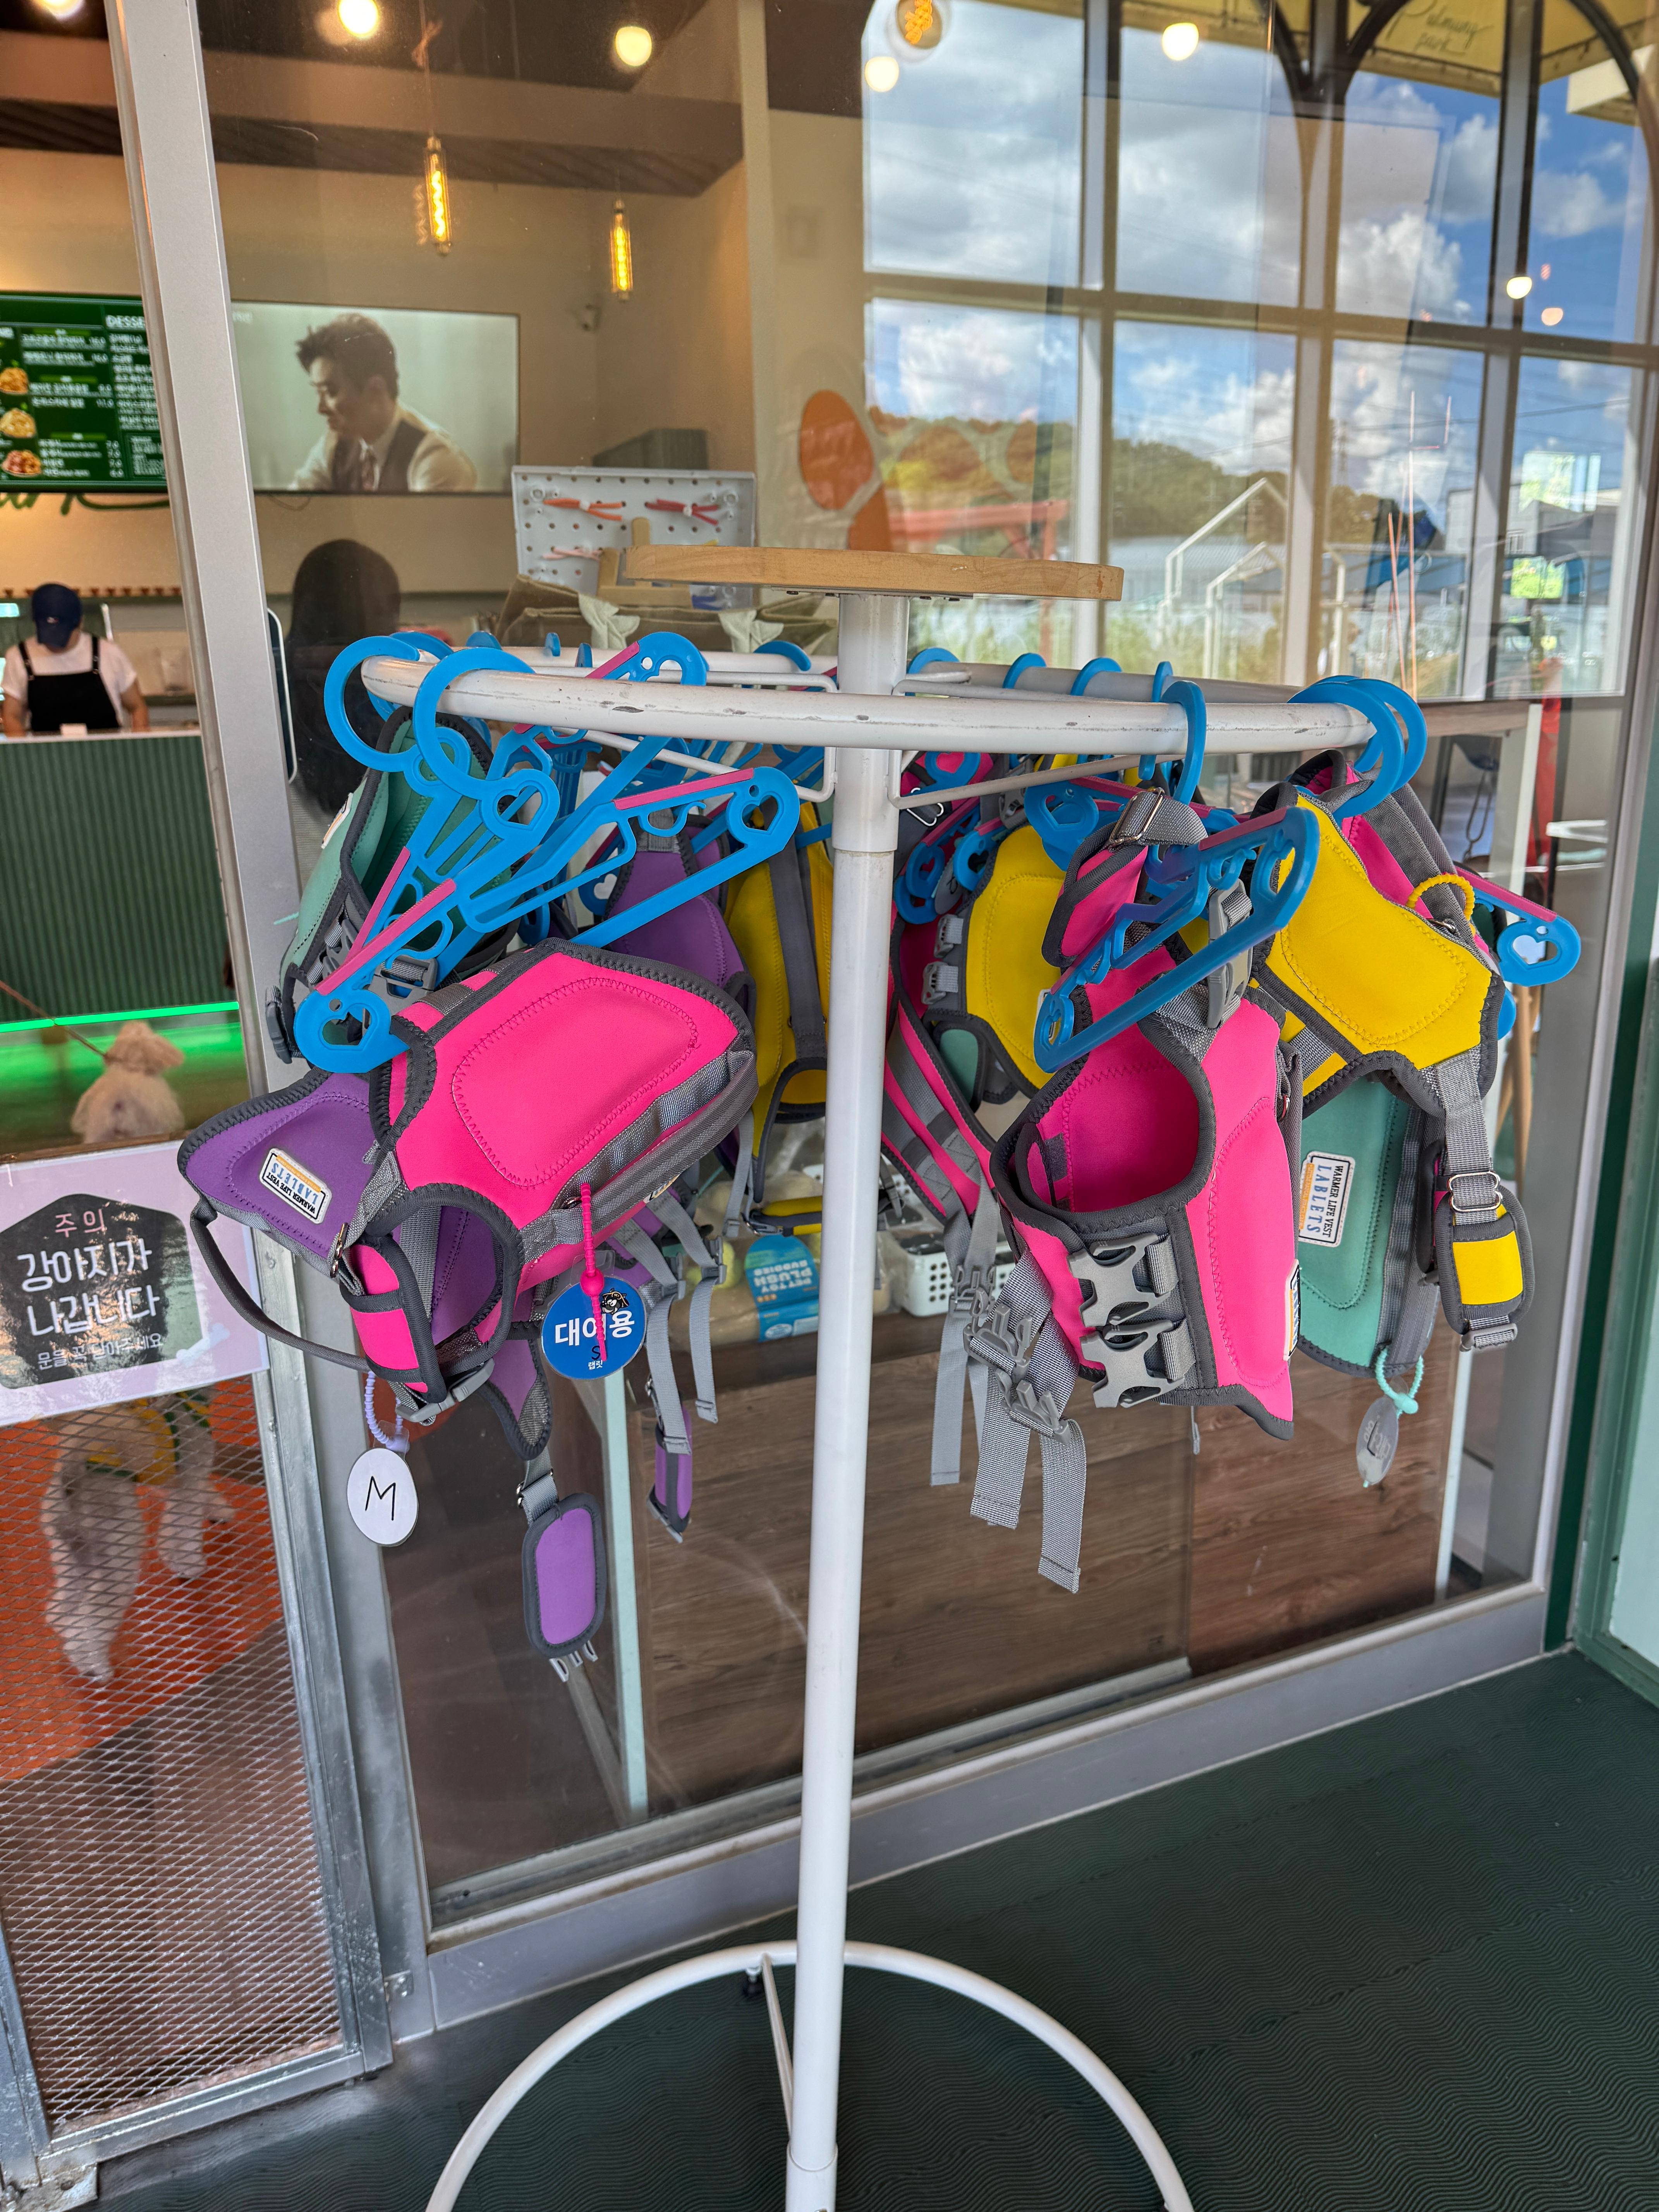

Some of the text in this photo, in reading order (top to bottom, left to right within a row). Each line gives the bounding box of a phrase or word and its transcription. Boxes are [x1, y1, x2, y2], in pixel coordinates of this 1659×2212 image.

[266, 1172, 316, 1214] WARMER LIFE VEST
[271, 1163, 318, 1204] LABLETS
[1307, 1164, 1332, 1233] LABLETS
[1322, 1166, 1343, 1237] WARMER LIFE VEST
[55, 1209, 106, 1238] 주의
[17, 1238, 153, 1292] 강아지가
[754, 1267, 812, 1287] PLUSH
[27, 1285, 160, 1336] 나갑니다
[38, 1349, 67, 1370] 문을
[365, 1476, 396, 1521] M
